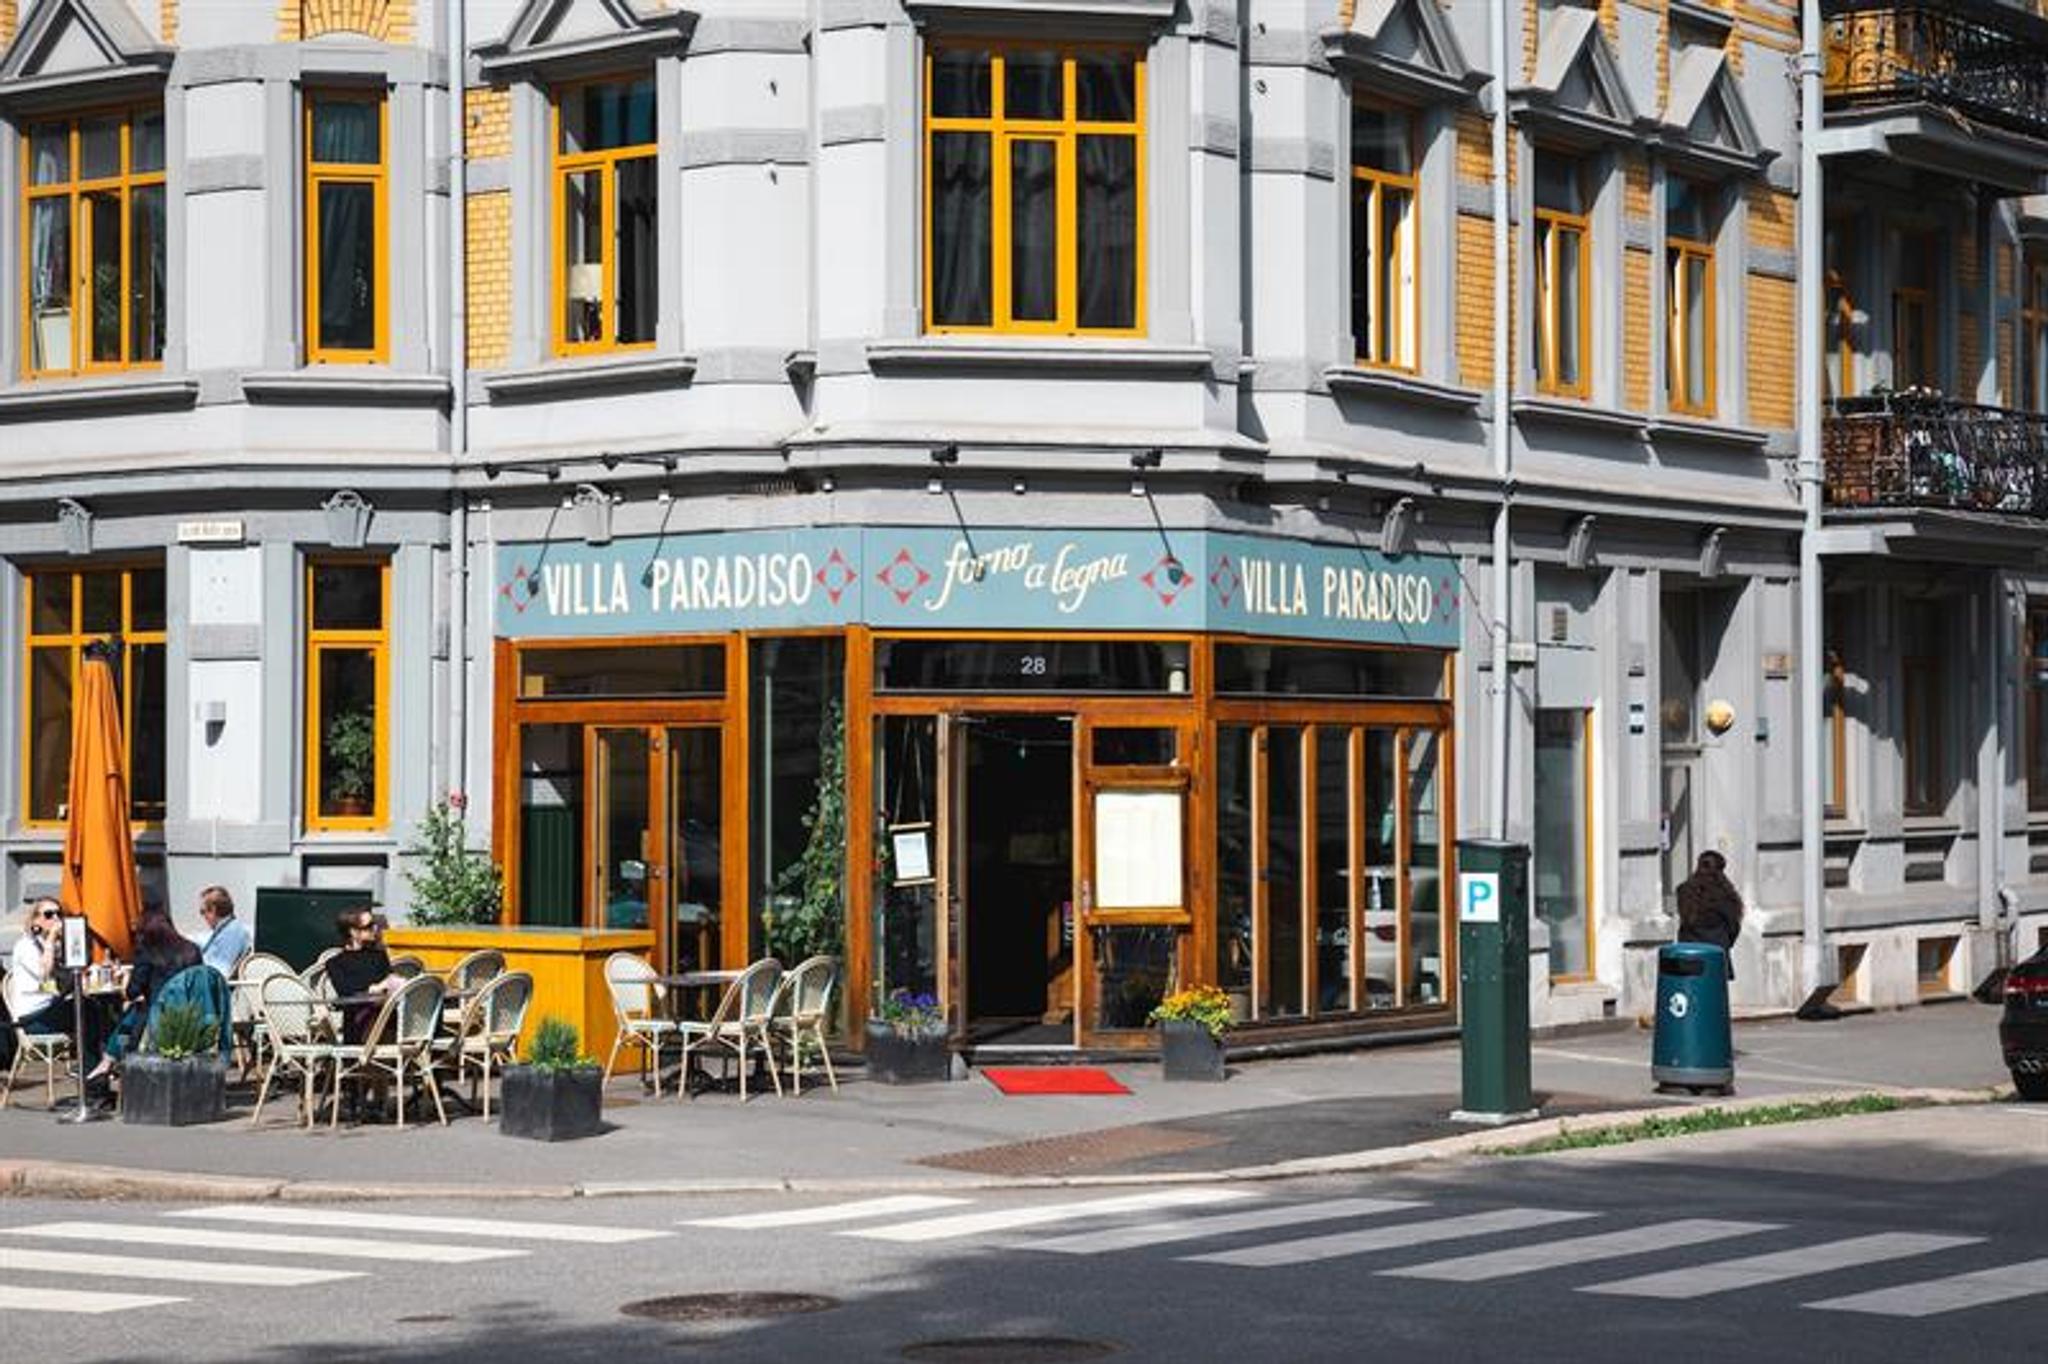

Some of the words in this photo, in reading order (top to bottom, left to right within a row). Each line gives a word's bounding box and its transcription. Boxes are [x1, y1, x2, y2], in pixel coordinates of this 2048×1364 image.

[543, 562, 629, 616] VILLA
[653, 553, 813, 612] PARADISO
[1024, 562, 1048, 588] a
[1051, 544, 1128, 613] legna
[1241, 557, 1308, 616] VILLA
[1323, 567, 1433, 624] PARADISO
[1021, 656, 1046, 675] 28
[1469, 881, 1491, 912] P
